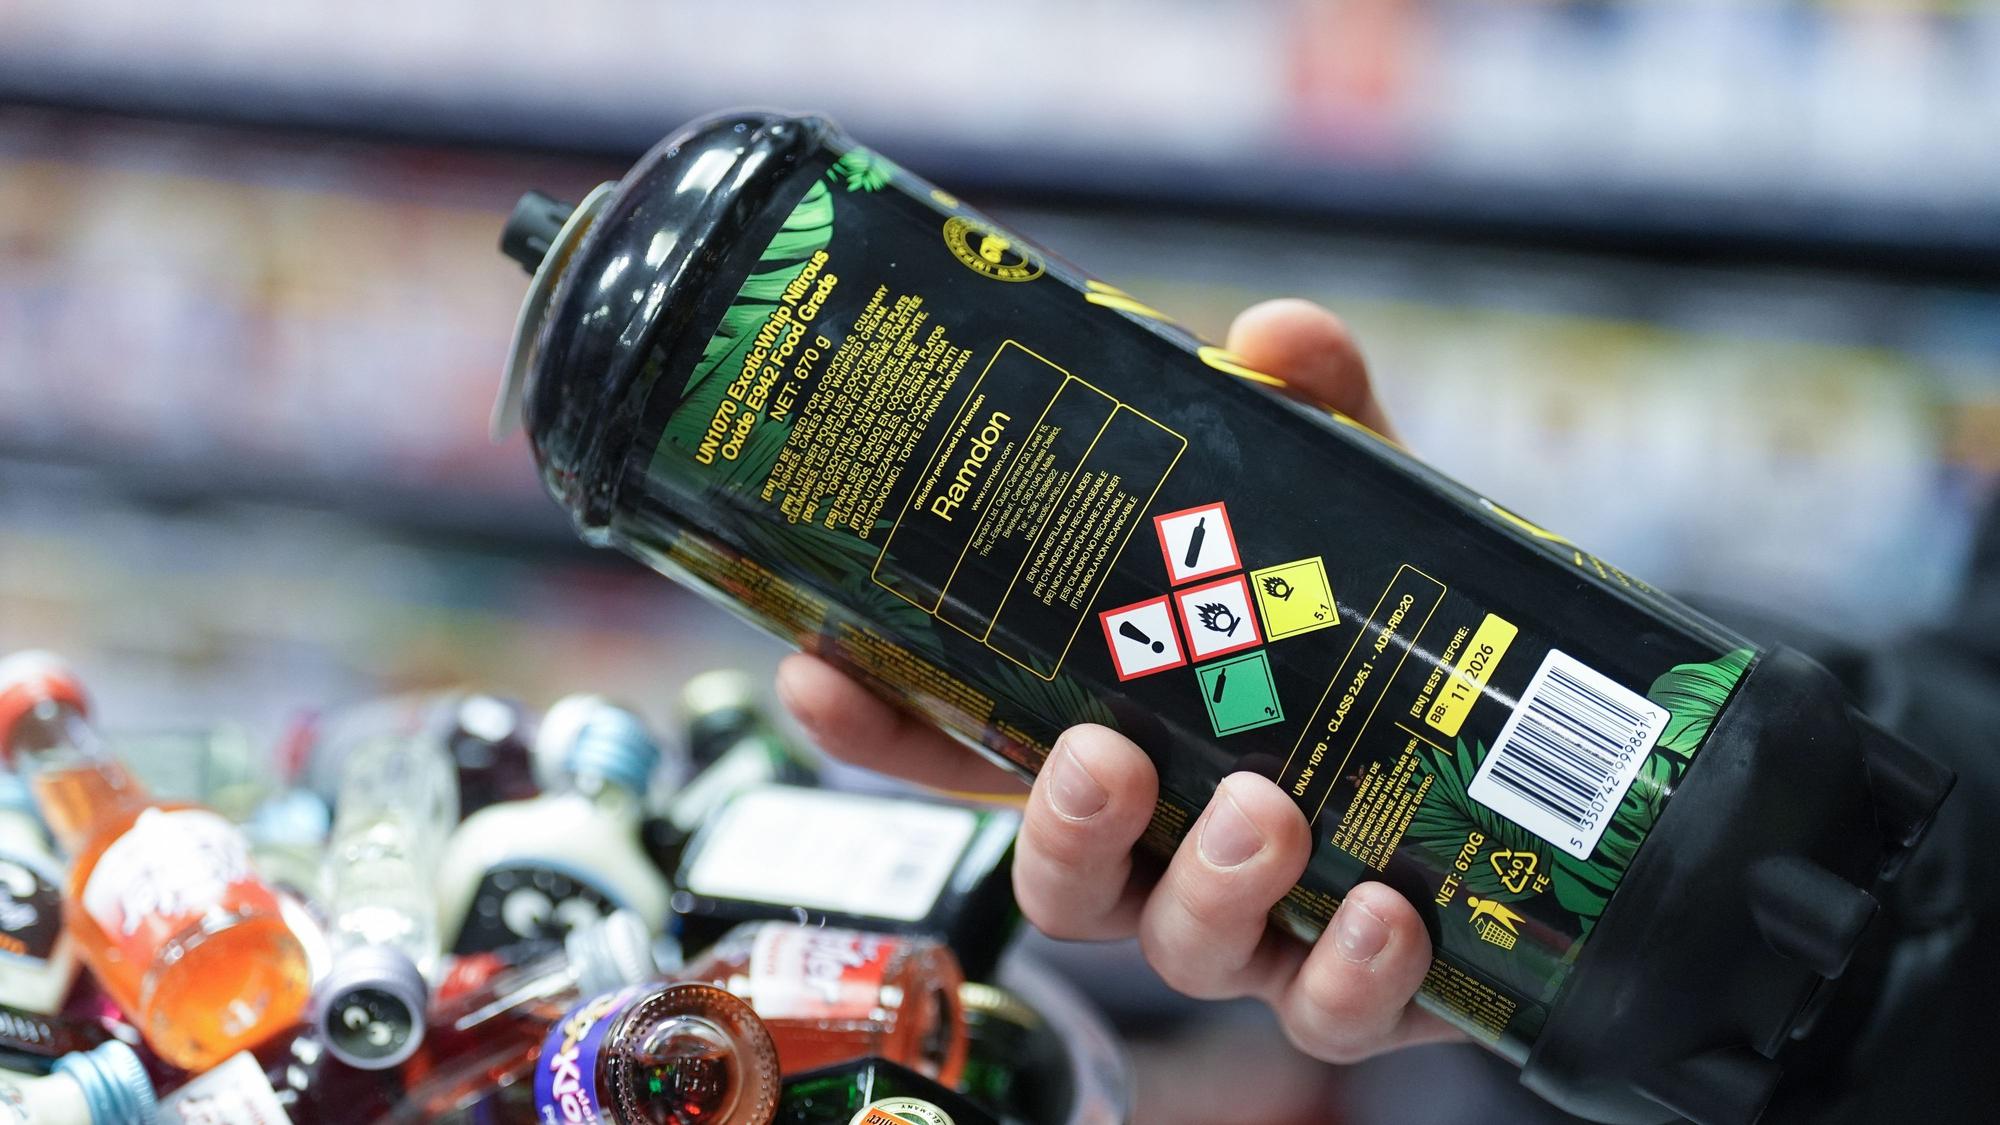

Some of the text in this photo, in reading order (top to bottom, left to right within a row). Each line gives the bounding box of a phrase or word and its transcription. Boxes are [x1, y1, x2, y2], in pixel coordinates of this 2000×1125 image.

[695, 246, 830, 466] UN1070 ExoticWhip Nitrous
[719, 270, 838, 462] Oxide E942 Food Grade
[760, 284, 890, 501] [EN] TO BE USED FOR COCKTAILS, CULINARY
[769, 334, 832, 422] NET: 670 g
[777, 302, 889, 491] DISHES, CAKES AND WHIPPED CREAM.
[779, 492, 796, 514] [FR]
[793, 442, 820, 486] UTILISER
[815, 413, 836, 443] POUR
[831, 393, 848, 413] LES
[842, 338, 881, 394] COCKTAILS,
[875, 320, 892, 340] LES
[887, 294, 911, 322] PLATS
[786, 466, 820, 524] CULINAIRES,
[814, 446, 830, 467] LES
[850, 385, 864, 401] ET
[859, 372, 872, 387] LA
[801, 500, 818, 522] [DE]
[821, 424, 857, 481] COCKTAILS,
[851, 355, 898, 425] KULINARISCHE
[892, 308, 929, 356] GERICHTE,
[824, 324, 946, 529] [ES] PARA SER USADO EN CÓCTELES, PLATOS
[825, 341, 918, 496] TORTEN UND ZUM SCHLAGSAHNE
[837, 337, 949, 524] CULINARIOS, PASTELES, Y CREMA BATIDA
[849, 345, 959, 530] [IT] DA UTILIZZARE PER COCKTAIL, PIATTI
[857, 347, 972, 540] GASTRONOMICI, TORTE E PANNA MONTATA
[912, 392, 986, 512] Officially produced by Ramdon
[930, 405, 1011, 522] Ramdon
[1010, 476, 1029, 501] Central
[1024, 447, 1046, 477] Business
[1041, 424, 1061, 448] District,
[969, 440, 1015, 512] www.ramdon.com
[972, 422, 1050, 549] Ramdon Ltd. Quad Central Q3, Level 15,
[1017, 518, 1029, 533] Tel:
[1024, 500, 1039, 519] +356
[1020, 470, 1045, 506] CBD1040,
[1039, 452, 1056, 472] Malta
[1024, 470, 1070, 542] Web: exotic-whip.com
[1025, 471, 1093, 583] [EN] NON-REFILLABLE CYLINDER
[1032, 470, 1109, 597] [FR] CYLINDER NON RECHARGEABLE
[1042, 588, 1056, 605] [DE]
[1050, 566, 1067, 590] NICHT
[1095, 474, 1121, 510] ZYLINDER
[1059, 490, 1126, 601] [ES] CILINDRO NO RECARGABLE
[1069, 495, 1138, 609] [IT] BOMBOLA NON RICARICABILE
[1313, 603, 1329, 621] 5.1
[1263, 705, 1275, 716] 2
[1409, 624, 1469, 718] [EN] BEST BEFORE:
[1429, 701, 1448, 724] BB:
[1450, 642, 1494, 703] 11/2026
[1292, 765, 1315, 797] UN.Nr
[1307, 741, 1328, 768] 1070
[1326, 693, 1355, 733] CLASS
[1348, 661, 1374, 696] 2.2/5.1
[1569, 720, 1652, 849] 5 350742 999861
[1330, 830, 1344, 846] [FR]
[1342, 773, 1374, 824] CONSOMMER
[1369, 760, 1381, 774] DE
[1349, 735, 1419, 857] [DE] MINDESTENS HALTBAR BIS:
[1358, 845, 1371, 862] [ES]
[1391, 770, 1411, 799] ANTES
[1406, 755, 1420, 771] DE:
[1365, 772, 1387, 803] AVANT:
[1367, 791, 1412, 868] [IT] DA CONSUMARSI
[1375, 772, 1435, 872] PREFERIBILMENTE ENTRO:
[1434, 830, 1485, 907] NET: 670G
[1505, 857, 1525, 879] 40
[1531, 872, 1550, 893] FE
